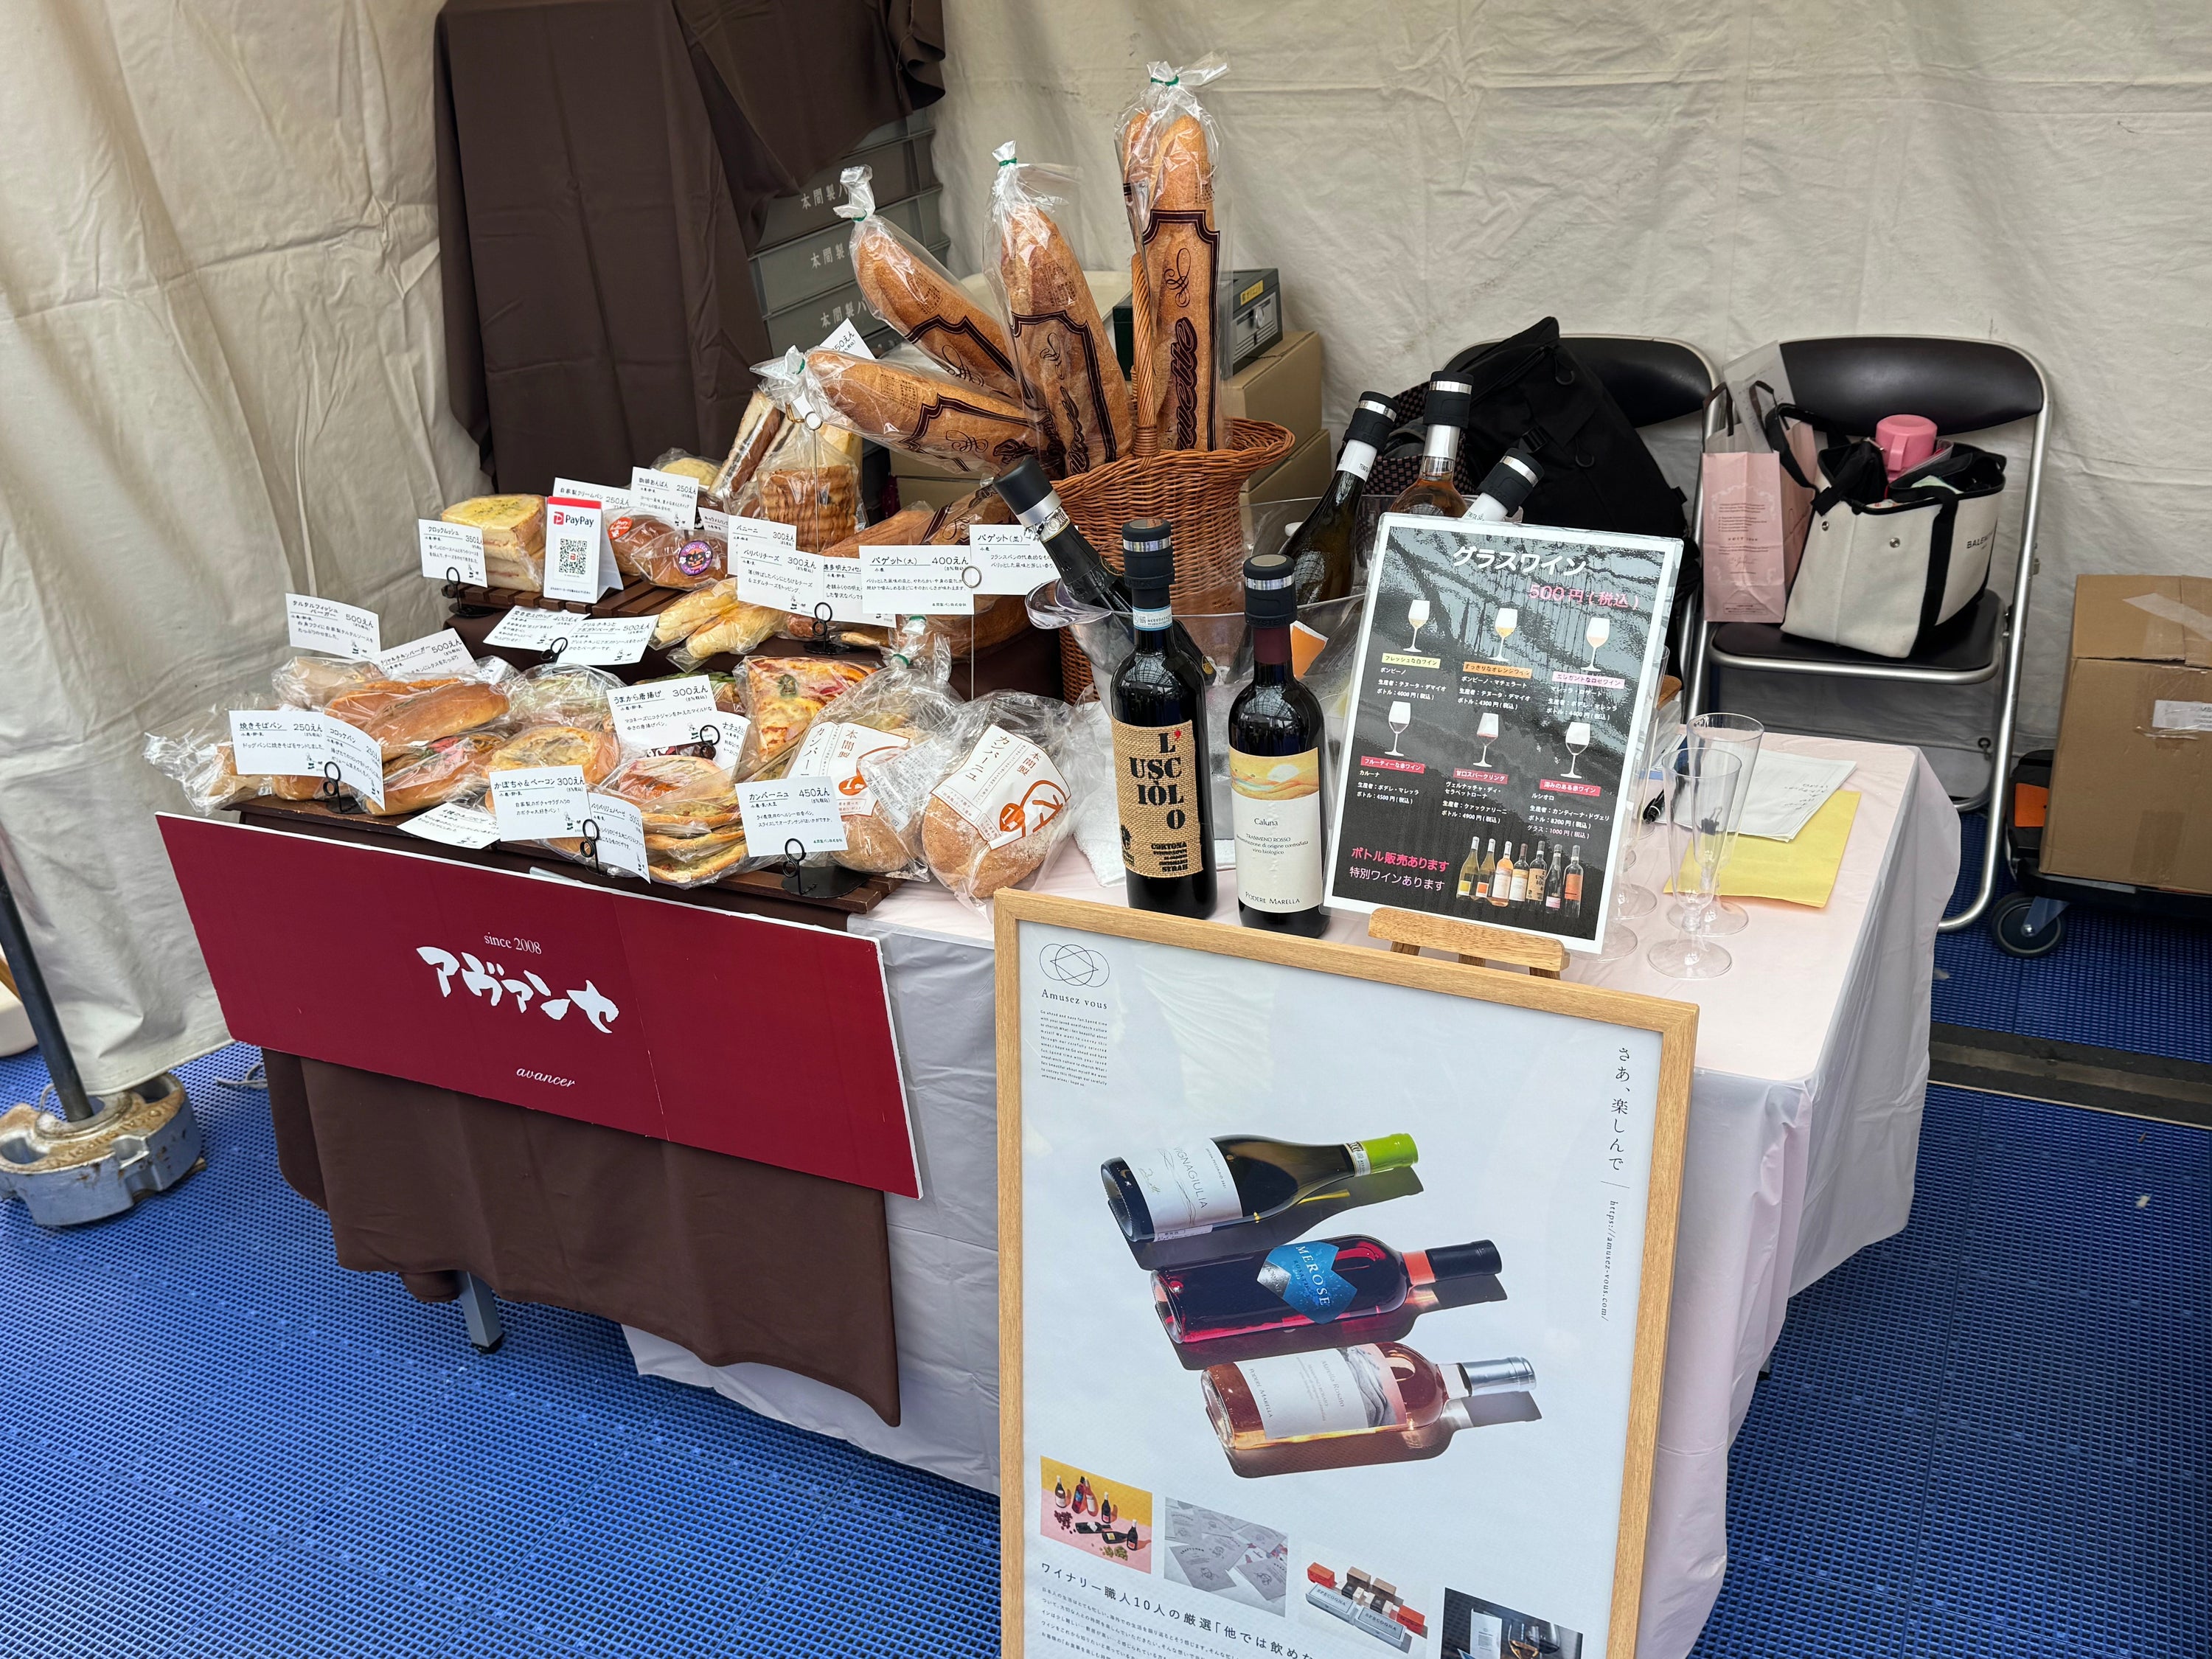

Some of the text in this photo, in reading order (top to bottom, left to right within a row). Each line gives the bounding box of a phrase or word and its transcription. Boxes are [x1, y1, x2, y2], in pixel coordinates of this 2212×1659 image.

[833, 331, 855, 352] 50えん
[676, 484, 696, 495] 250えん
[605, 496, 630, 507] 250えん
[566, 515, 594, 528] PayPay
[773, 532, 795, 543] 300えん
[787, 557, 817, 570] 300えん
[931, 556, 969, 566] 400えん
[1453, 545, 1587, 577] グラスワイン
[824, 564, 861, 572] 博多明太フィセ
[293, 600, 338, 613] タルタルフィッシュ
[310, 609, 336, 617] バーガー
[345, 613, 374, 628] 500えん
[623, 623, 650, 632] 500えん
[431, 640, 463, 654] 500えん
[1385, 655, 1438, 667] フレッシュな白ワイン
[613, 690, 662, 705] うまから唐揚げ
[672, 685, 709, 698] 300えん
[240, 722, 282, 730] 焼きそばパン
[293, 723, 323, 732] 250えん
[330, 728, 356, 743] コロッケパン
[965, 736, 1010, 782] カンパーニュ
[1129, 757, 1182, 779] USC
[1359, 770, 1380, 778] カルーナ
[557, 776, 585, 787] 300えん
[1455, 770, 1506, 782] 甘口スパークリング
[749, 791, 790, 801] カンパーニュ
[799, 787, 830, 798] 450えん
[1531, 793, 1555, 801] ルシオロ
[1166, 808, 1186, 830] O
[1254, 818, 1279, 826] Caluna
[1351, 847, 1450, 873] ボトル販売あります
[1349, 866, 1445, 891] 特別ワインあります
[484, 932, 542, 955] since 2008
[416, 946, 620, 1034] アヴァンセ
[1041, 989, 1107, 1009] Amusez vous
[516, 1067, 575, 1087] avancer
[1609, 1047, 1630, 1171] さあ、楽しんで
